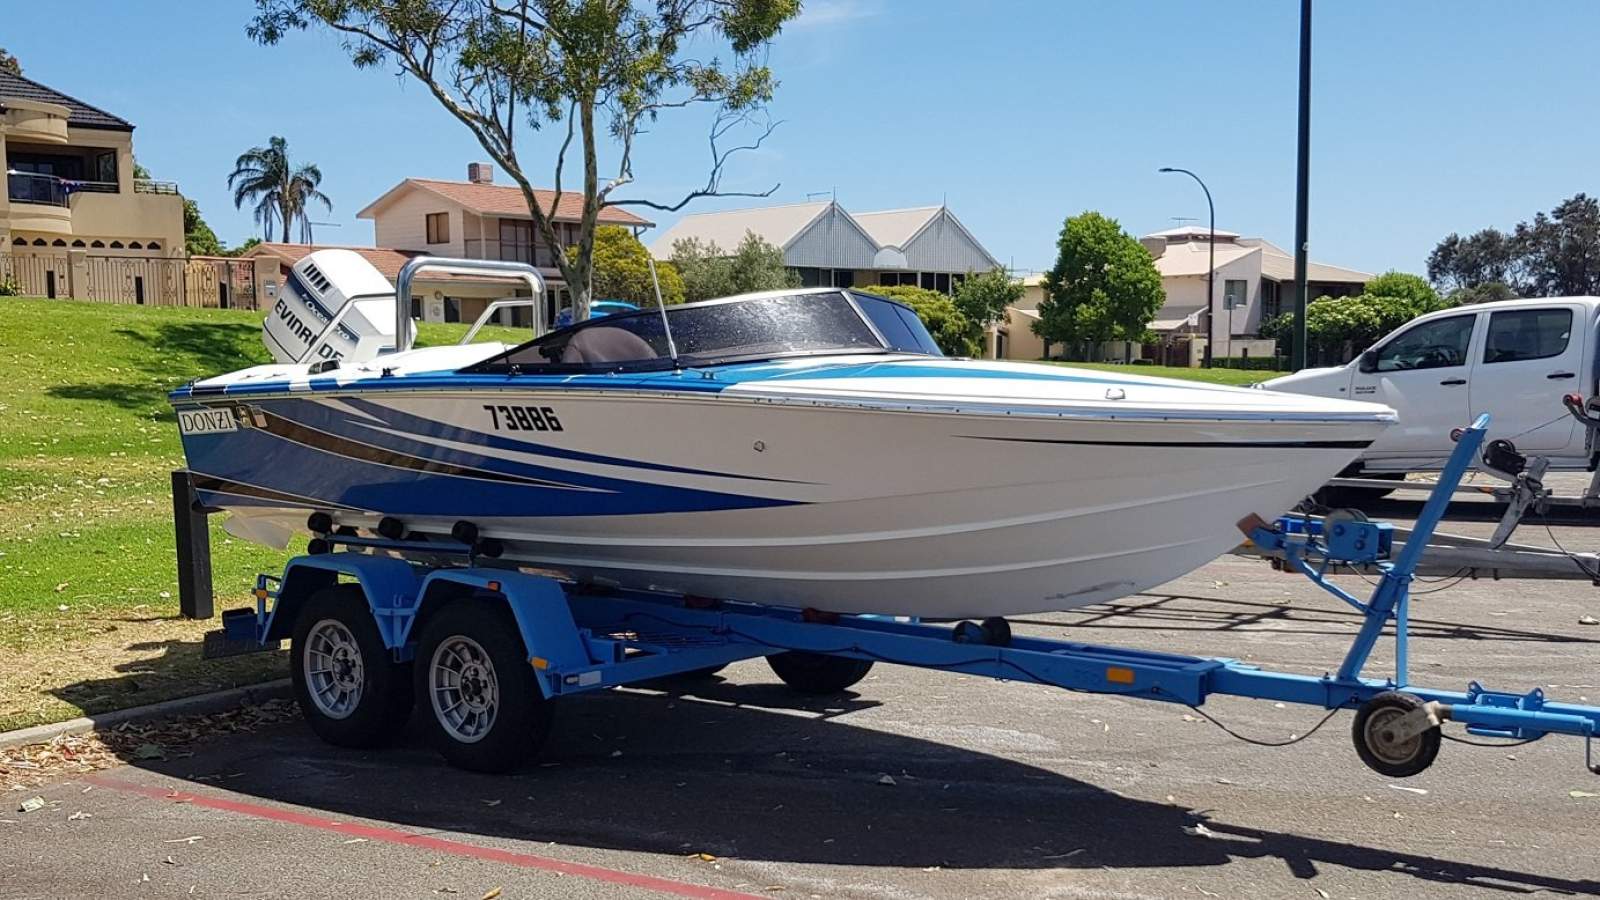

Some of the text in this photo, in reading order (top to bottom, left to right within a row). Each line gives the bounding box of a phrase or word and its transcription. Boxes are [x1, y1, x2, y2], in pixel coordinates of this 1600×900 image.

[306, 301, 329, 324] Ocea
[181, 411, 233, 432] DONZI
[482, 405, 564, 432] 73886
